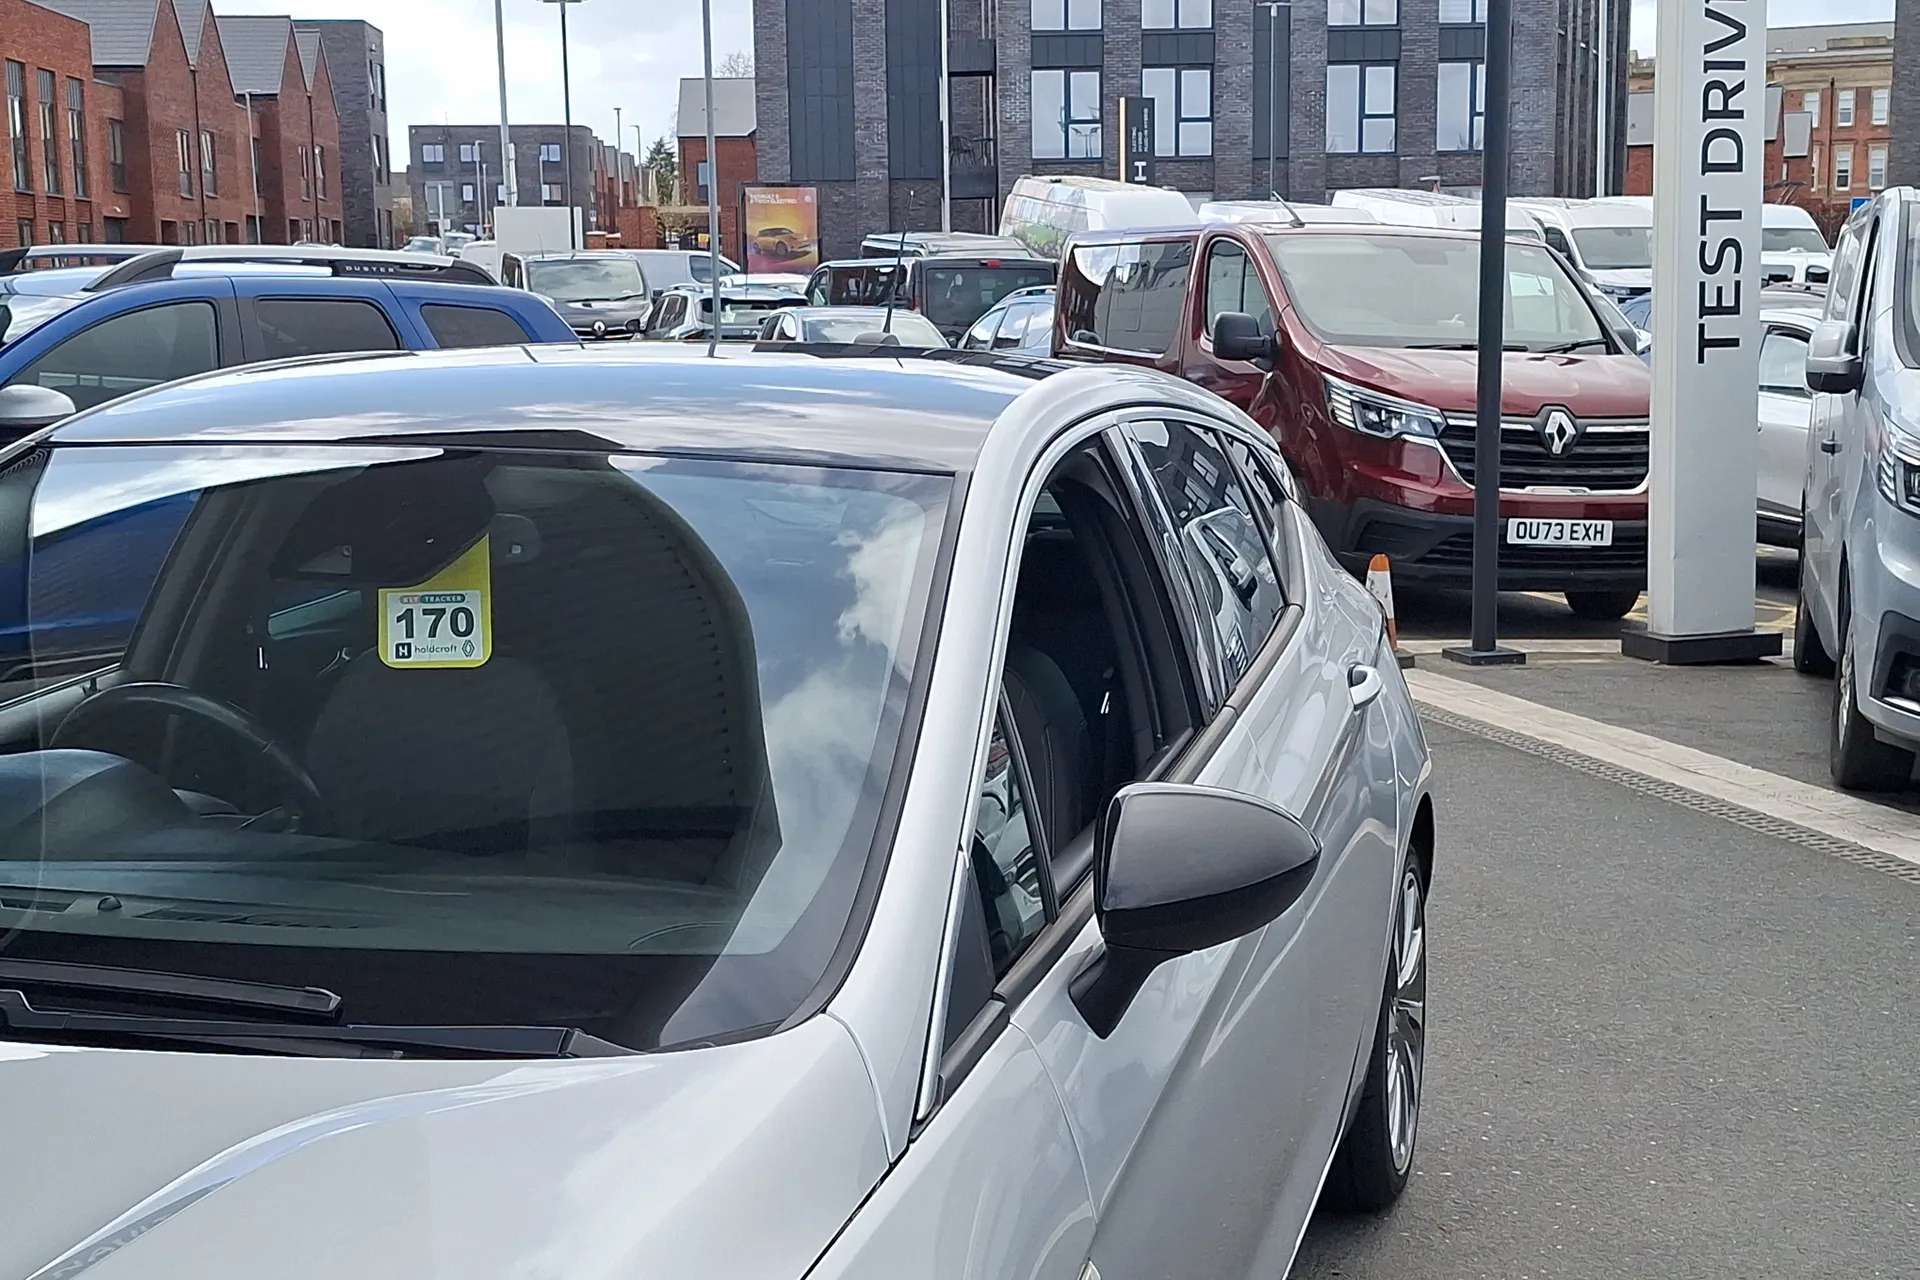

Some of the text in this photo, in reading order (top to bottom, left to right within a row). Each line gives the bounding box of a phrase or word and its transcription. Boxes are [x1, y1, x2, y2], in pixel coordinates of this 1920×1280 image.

[1698, 0, 1746, 364] TEST DRIV
[345, 265, 394, 273] DUSTER
[1516, 521, 1605, 541] OU73 EXH
[424, 594, 464, 603] TRACKER
[396, 606, 475, 639] 170
[414, 643, 457, 654] holdcroft
